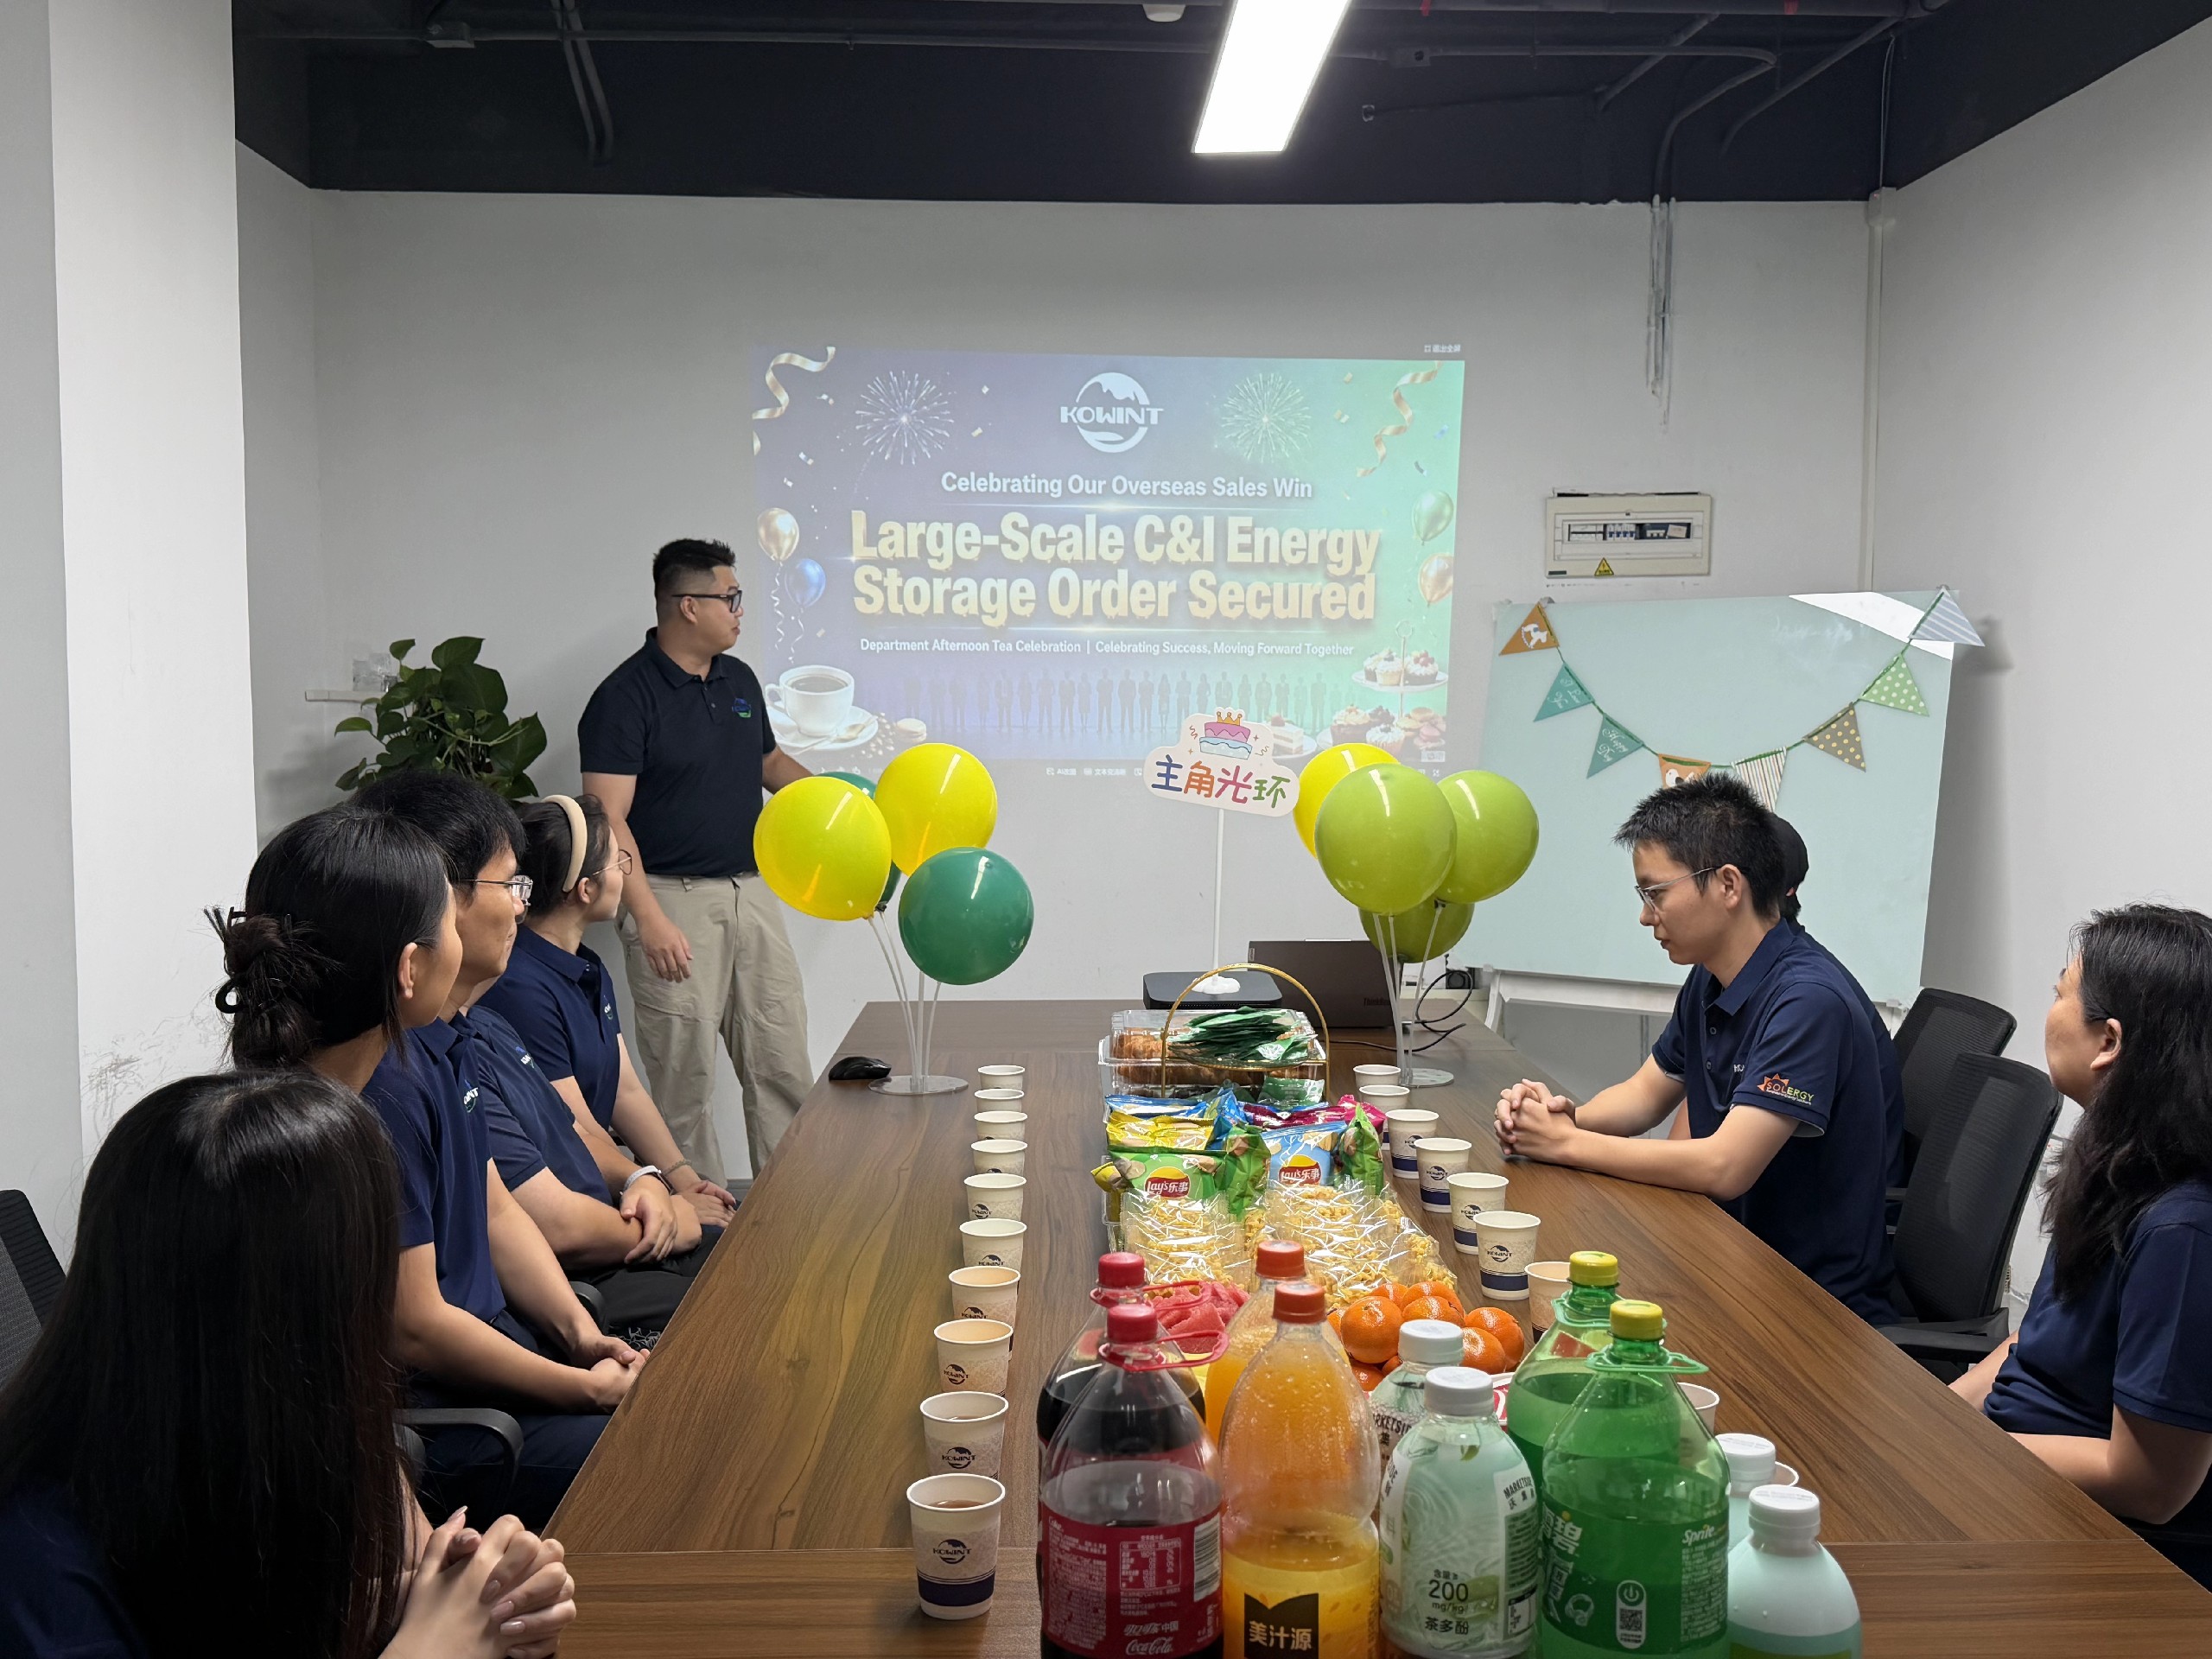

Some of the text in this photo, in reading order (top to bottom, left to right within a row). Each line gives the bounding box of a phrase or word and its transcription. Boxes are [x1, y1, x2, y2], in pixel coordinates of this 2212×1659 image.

[1060, 406, 1164, 424] KOWINT
[941, 472, 1313, 498] Celebrating Our Overseas Sales Win
[851, 510, 1381, 576] Large-Scale C&I Energy
[853, 565, 1376, 627] Storage Order Secured
[861, 639, 1354, 657] Department Afternoon Tea Celebration Celebrating Success, Moving Forward Together
[1151, 754, 1291, 808] 主角光环
[1767, 1082, 1815, 1102] SOLERGY
[944, 1370, 969, 1379] KOWINT
[1681, 1524, 1715, 1546] Sprite
[932, 1547, 972, 1556] KOWINT
[1428, 1580, 1469, 1602] 200
[1432, 1602, 1466, 1615] mg/kg
[1249, 1620, 1313, 1651] 美汁源
[1425, 1616, 1469, 1636] 茶多酚
